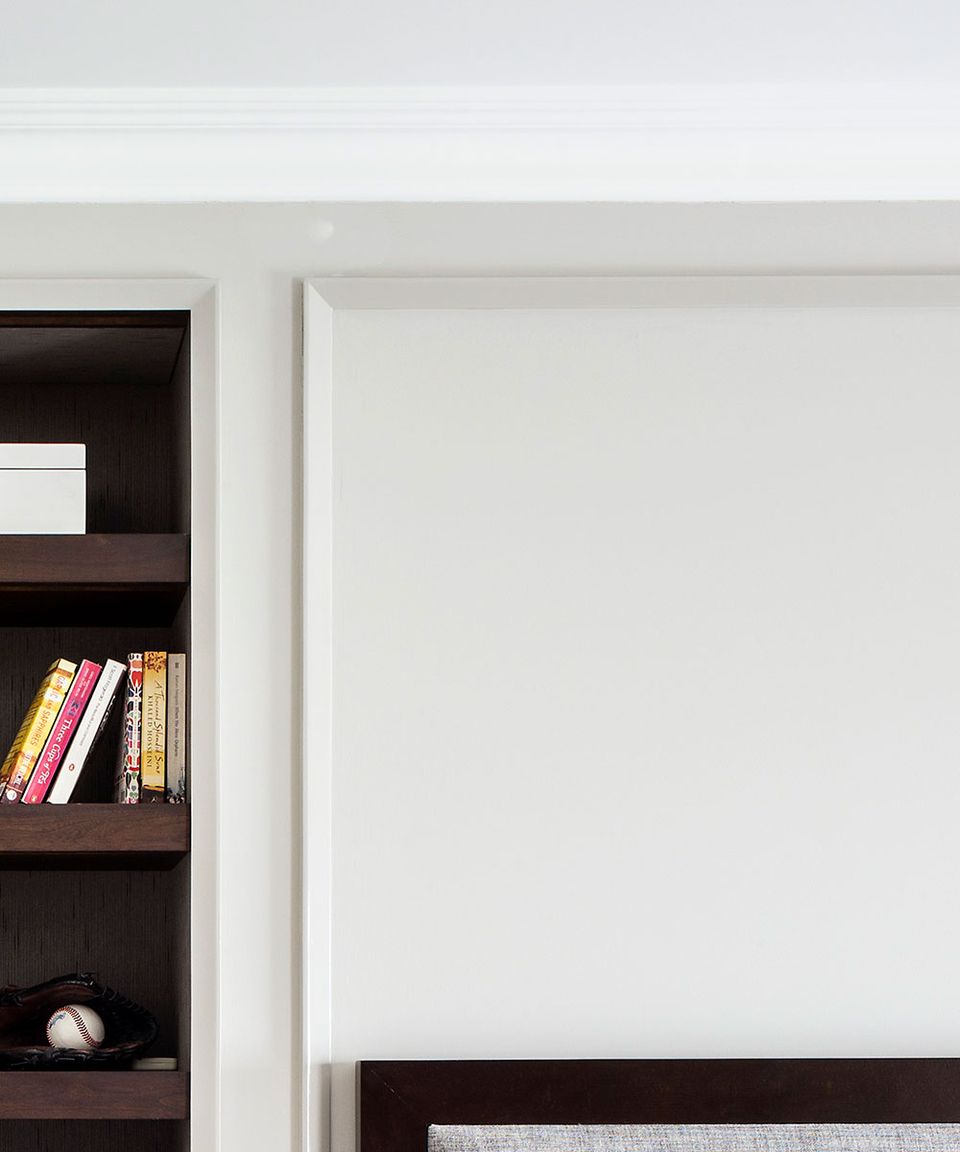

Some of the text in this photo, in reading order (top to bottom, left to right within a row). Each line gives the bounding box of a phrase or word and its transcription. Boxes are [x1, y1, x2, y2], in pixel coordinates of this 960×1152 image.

[155, 680, 163, 689] A
[31, 709, 51, 746] SAPPHIRES
[55, 718, 72, 742] Three
[153, 722, 163, 753] Splendid
[46, 742, 62, 763] Cups
[155, 755, 163, 774] Suns
[37, 770, 49, 785] Tea
